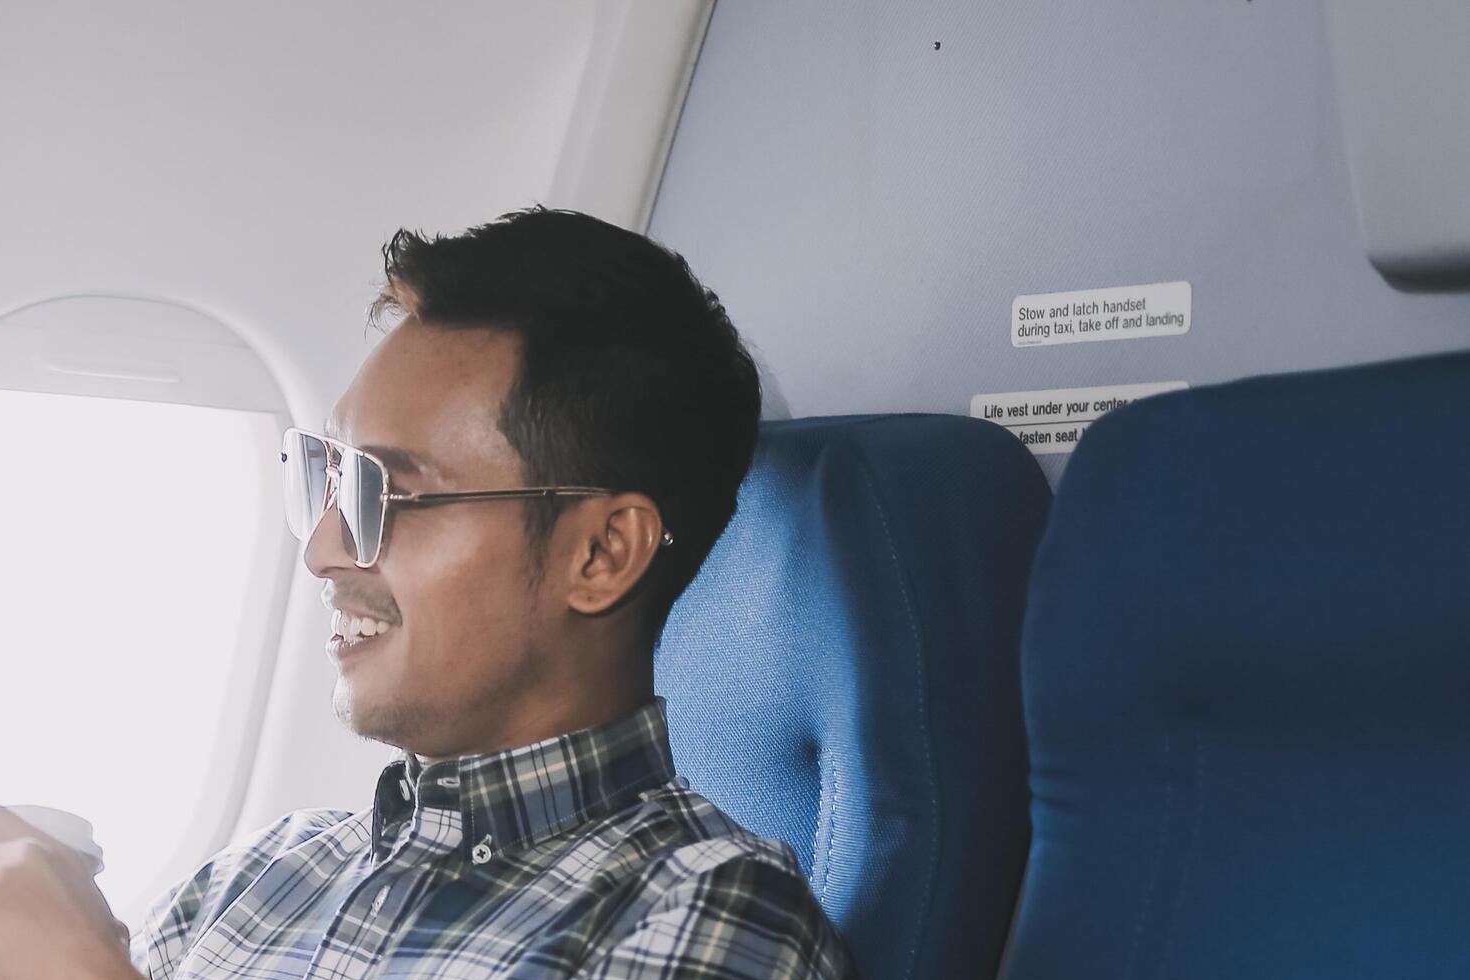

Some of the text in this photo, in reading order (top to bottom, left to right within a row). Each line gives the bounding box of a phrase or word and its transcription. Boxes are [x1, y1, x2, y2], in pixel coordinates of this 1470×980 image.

[1019, 298, 1146, 321] Stow and latch handset
[1018, 312, 1184, 338] during taxi, take off and landing
[984, 403, 1004, 419] Life
[1007, 403, 1028, 416] vest
[1032, 400, 1062, 415] under
[1067, 400, 1089, 416] your
[1055, 428, 1077, 442] seat
